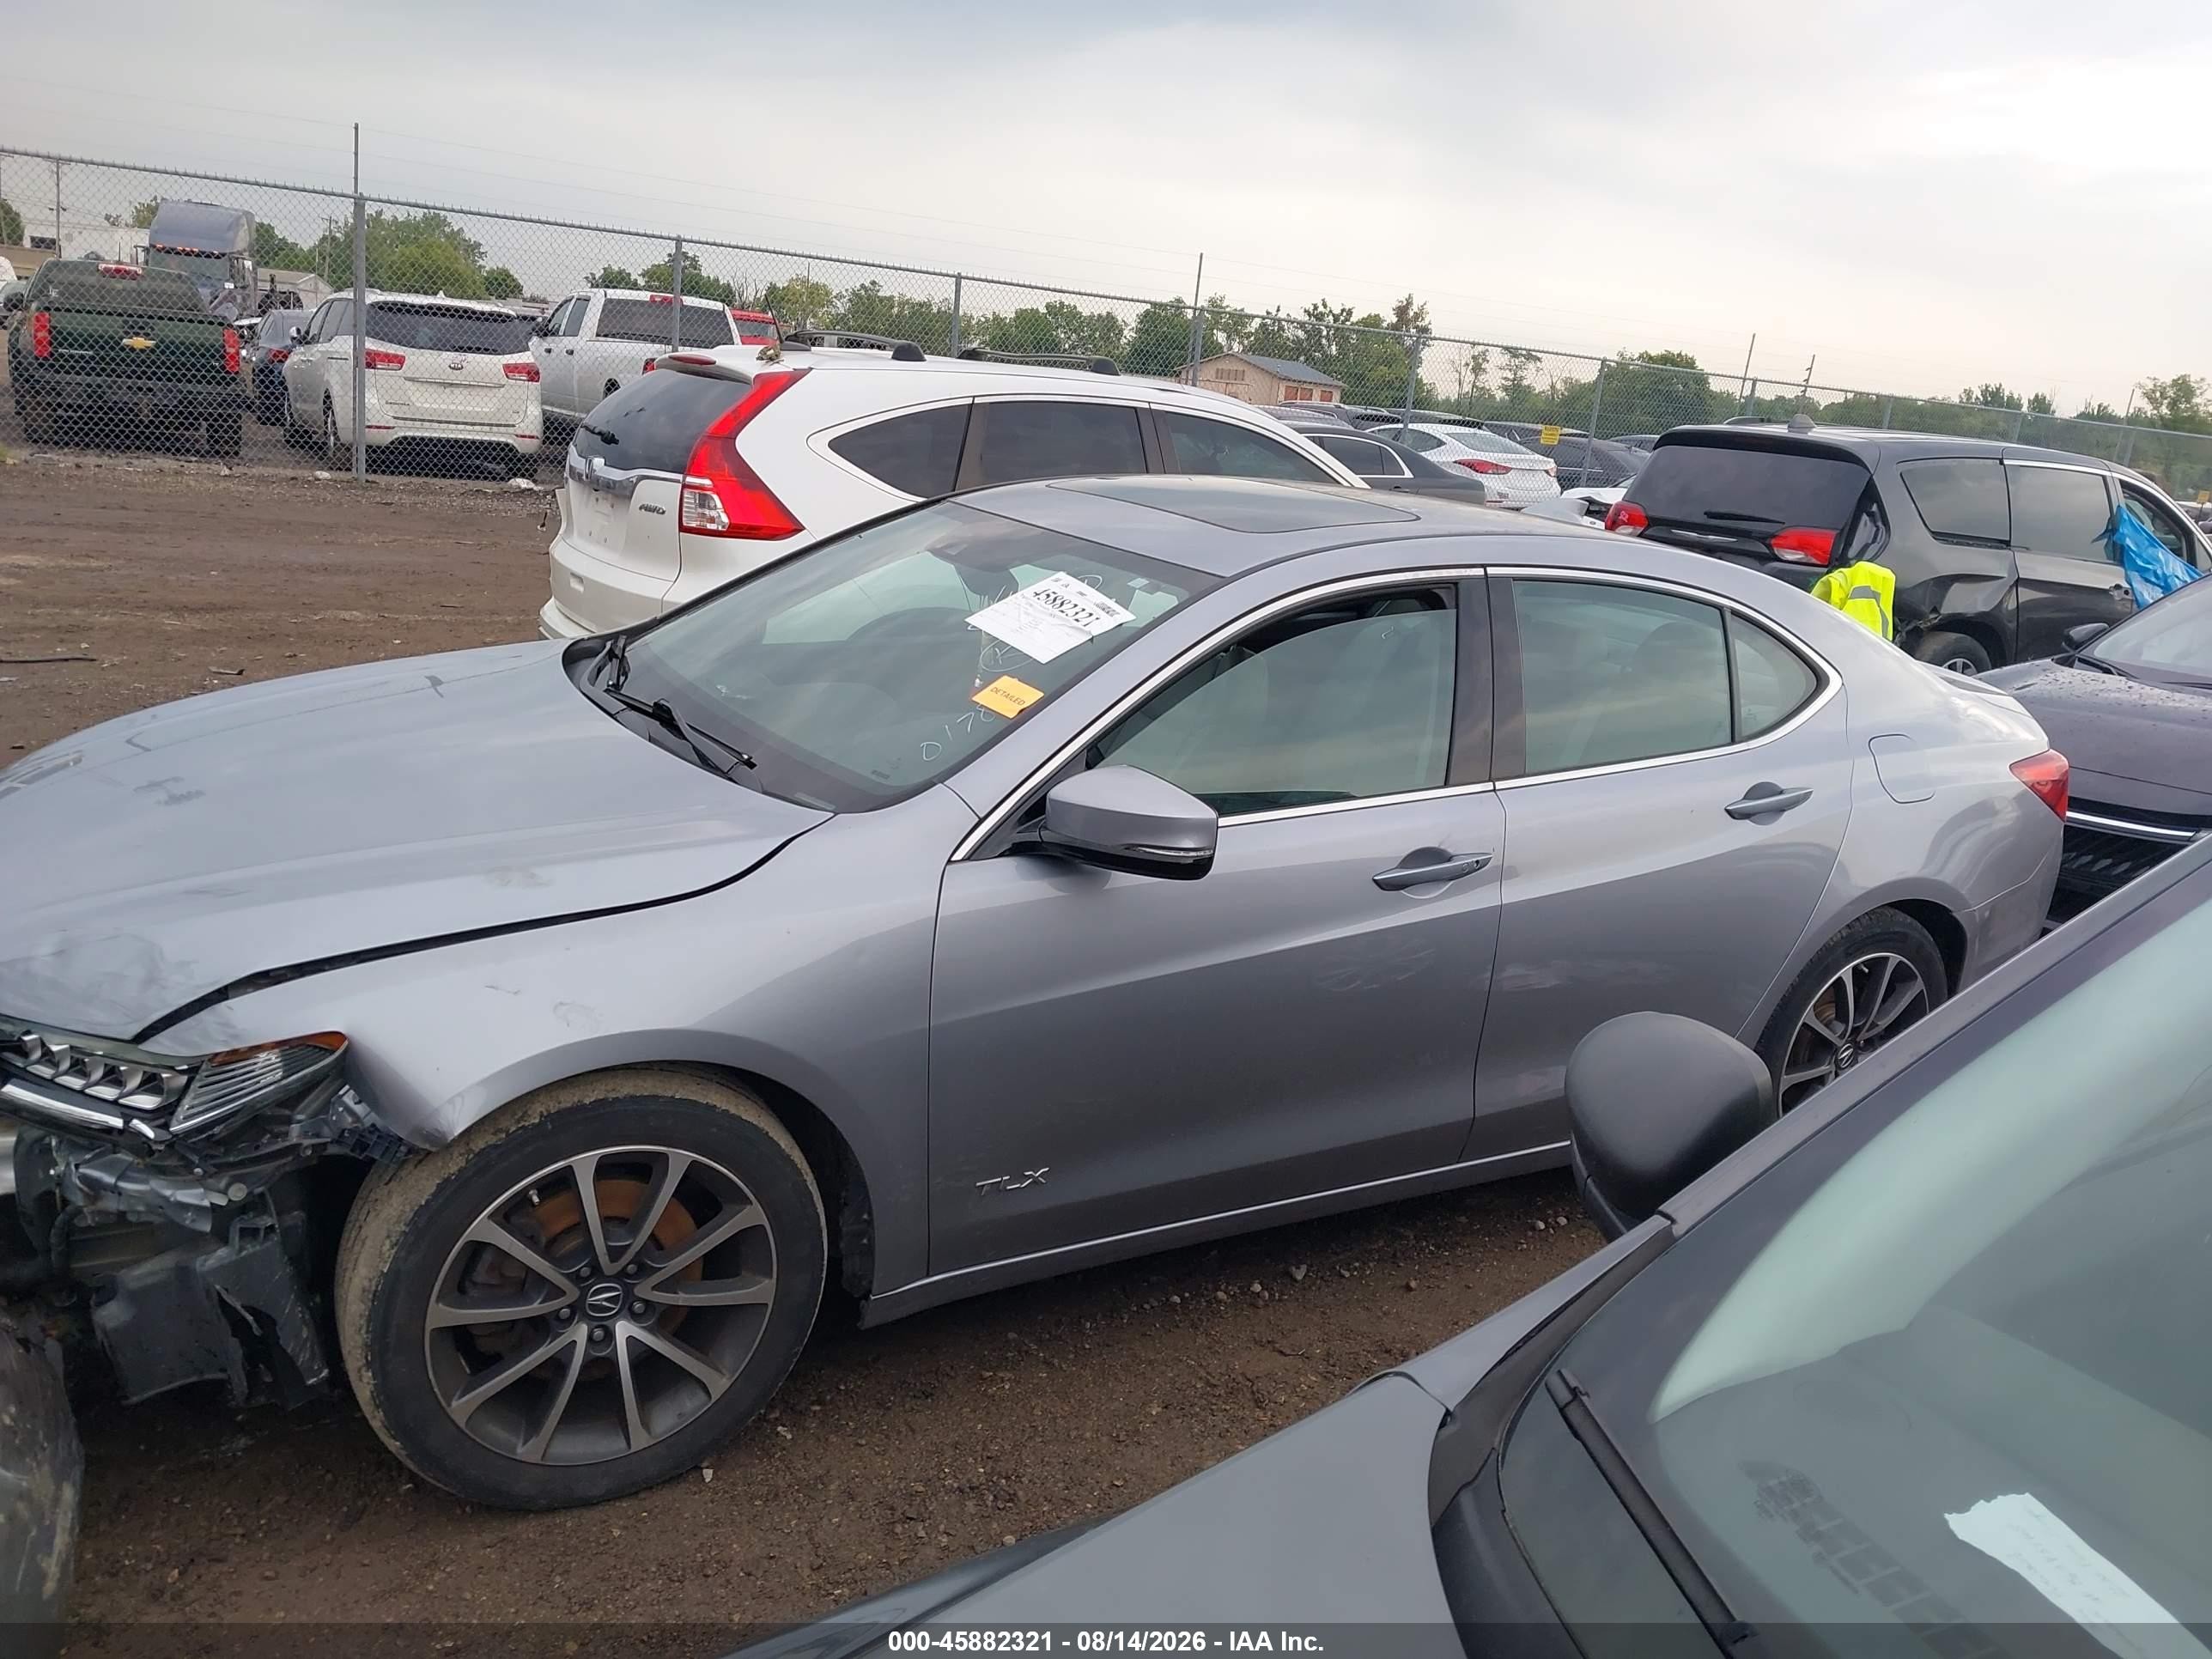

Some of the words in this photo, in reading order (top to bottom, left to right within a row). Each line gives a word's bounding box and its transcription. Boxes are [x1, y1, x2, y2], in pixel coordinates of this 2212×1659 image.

[1032, 587, 1102, 628] 45882321
[990, 686, 1026, 706] DETAILED
[975, 1167, 1050, 1196] TLX
